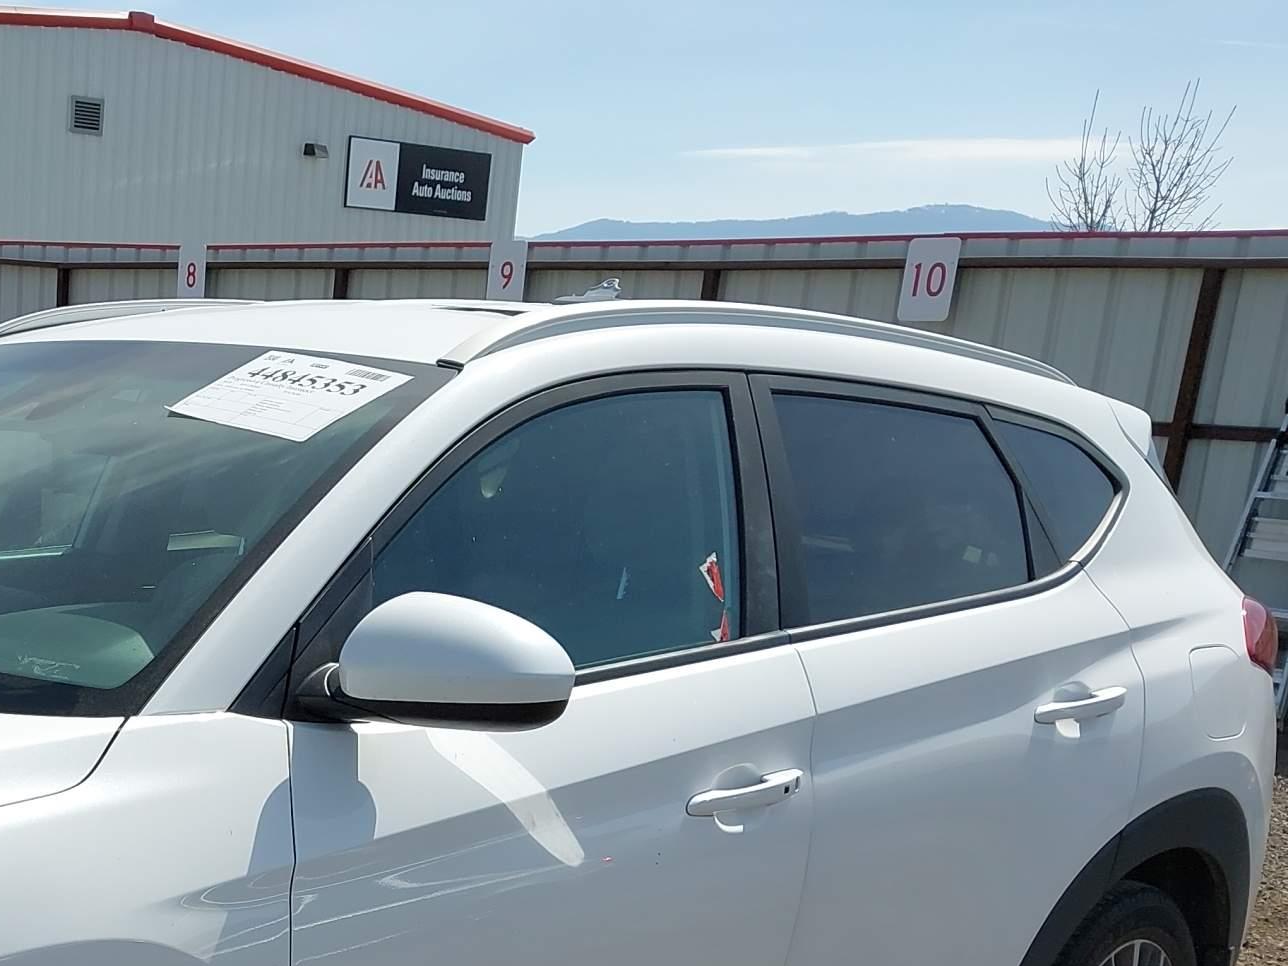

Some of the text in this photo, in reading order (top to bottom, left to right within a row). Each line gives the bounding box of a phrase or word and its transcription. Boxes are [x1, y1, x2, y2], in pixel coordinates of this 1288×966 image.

[421, 164, 465, 183] Insurance
[411, 182, 472, 203] Auto Auctions
[186, 262, 197, 289] 8
[500, 261, 514, 290] 9
[911, 262, 947, 298] 10
[248, 366, 368, 396] 44845353
